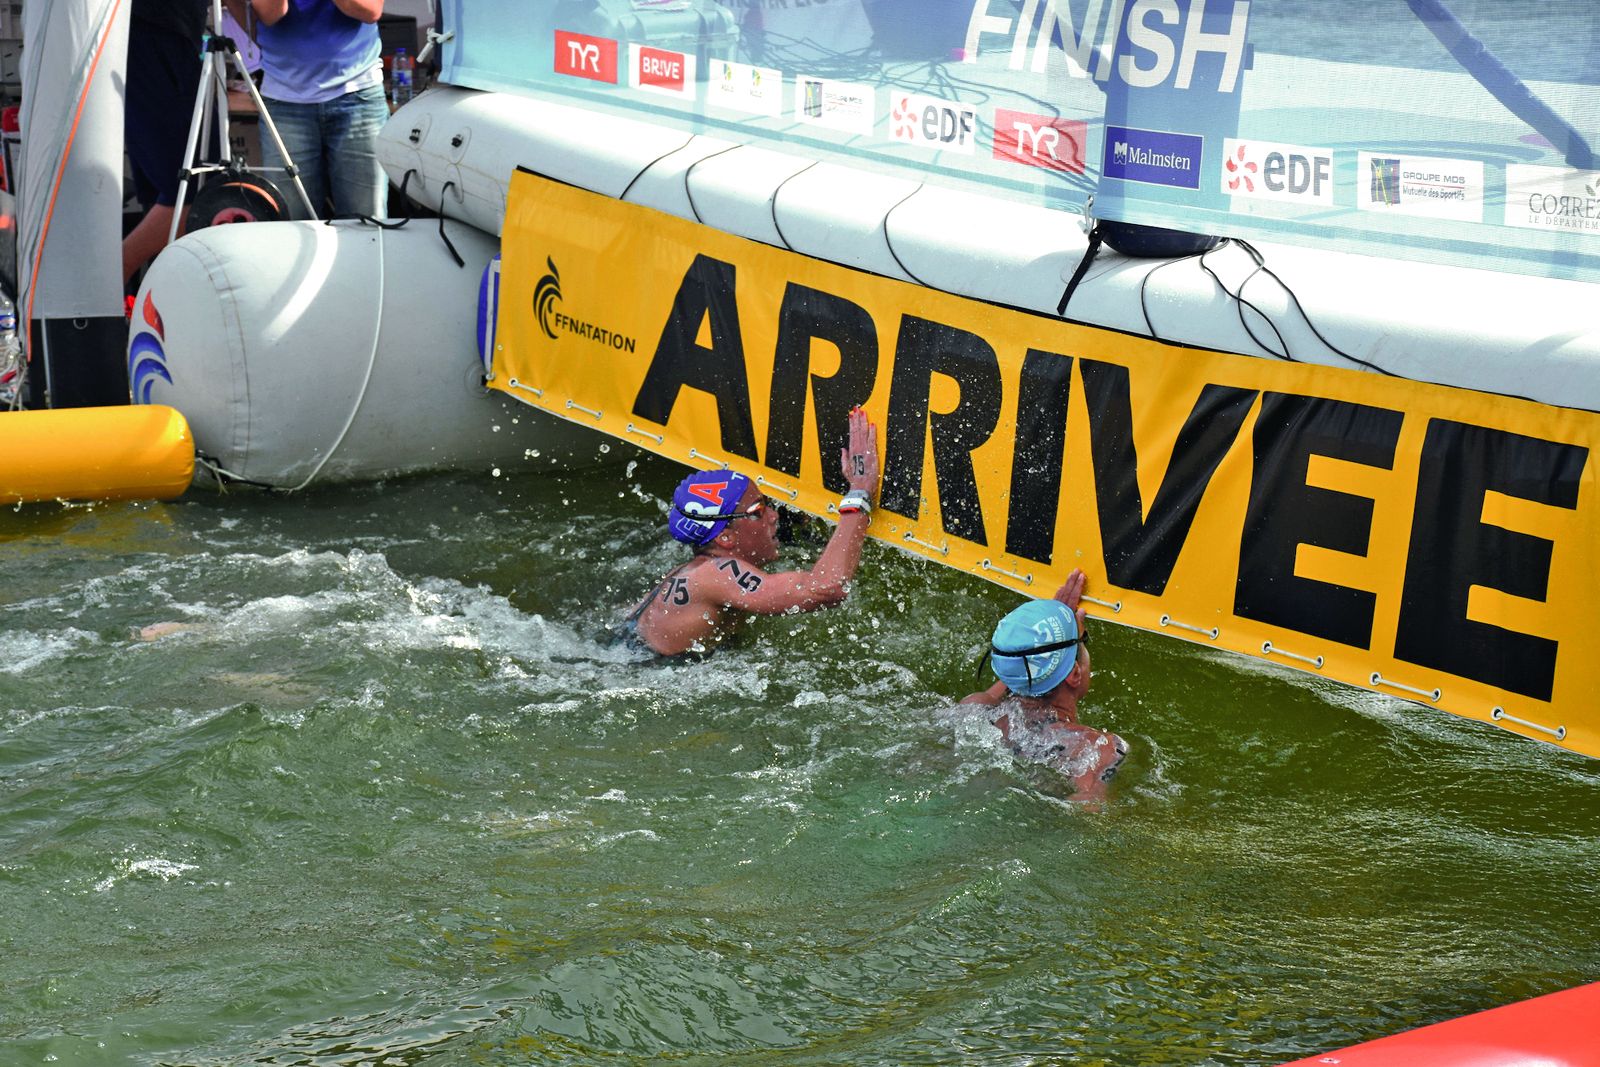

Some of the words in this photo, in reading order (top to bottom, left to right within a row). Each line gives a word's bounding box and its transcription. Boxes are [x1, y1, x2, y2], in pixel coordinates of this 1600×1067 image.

[567, 40, 600, 73] TYR
[961, 0, 1250, 93] FINISH
[1013, 121, 1059, 161] TYR
[1128, 147, 1191, 170] Malmsten
[1402, 171, 1441, 182] GROUPE
[1443, 175, 1466, 185] MDS
[555, 312, 636, 354] FFNATATION
[632, 253, 1589, 702] ARRIVEE
[662, 577, 690, 606] 75
[718, 559, 762, 593] 75
